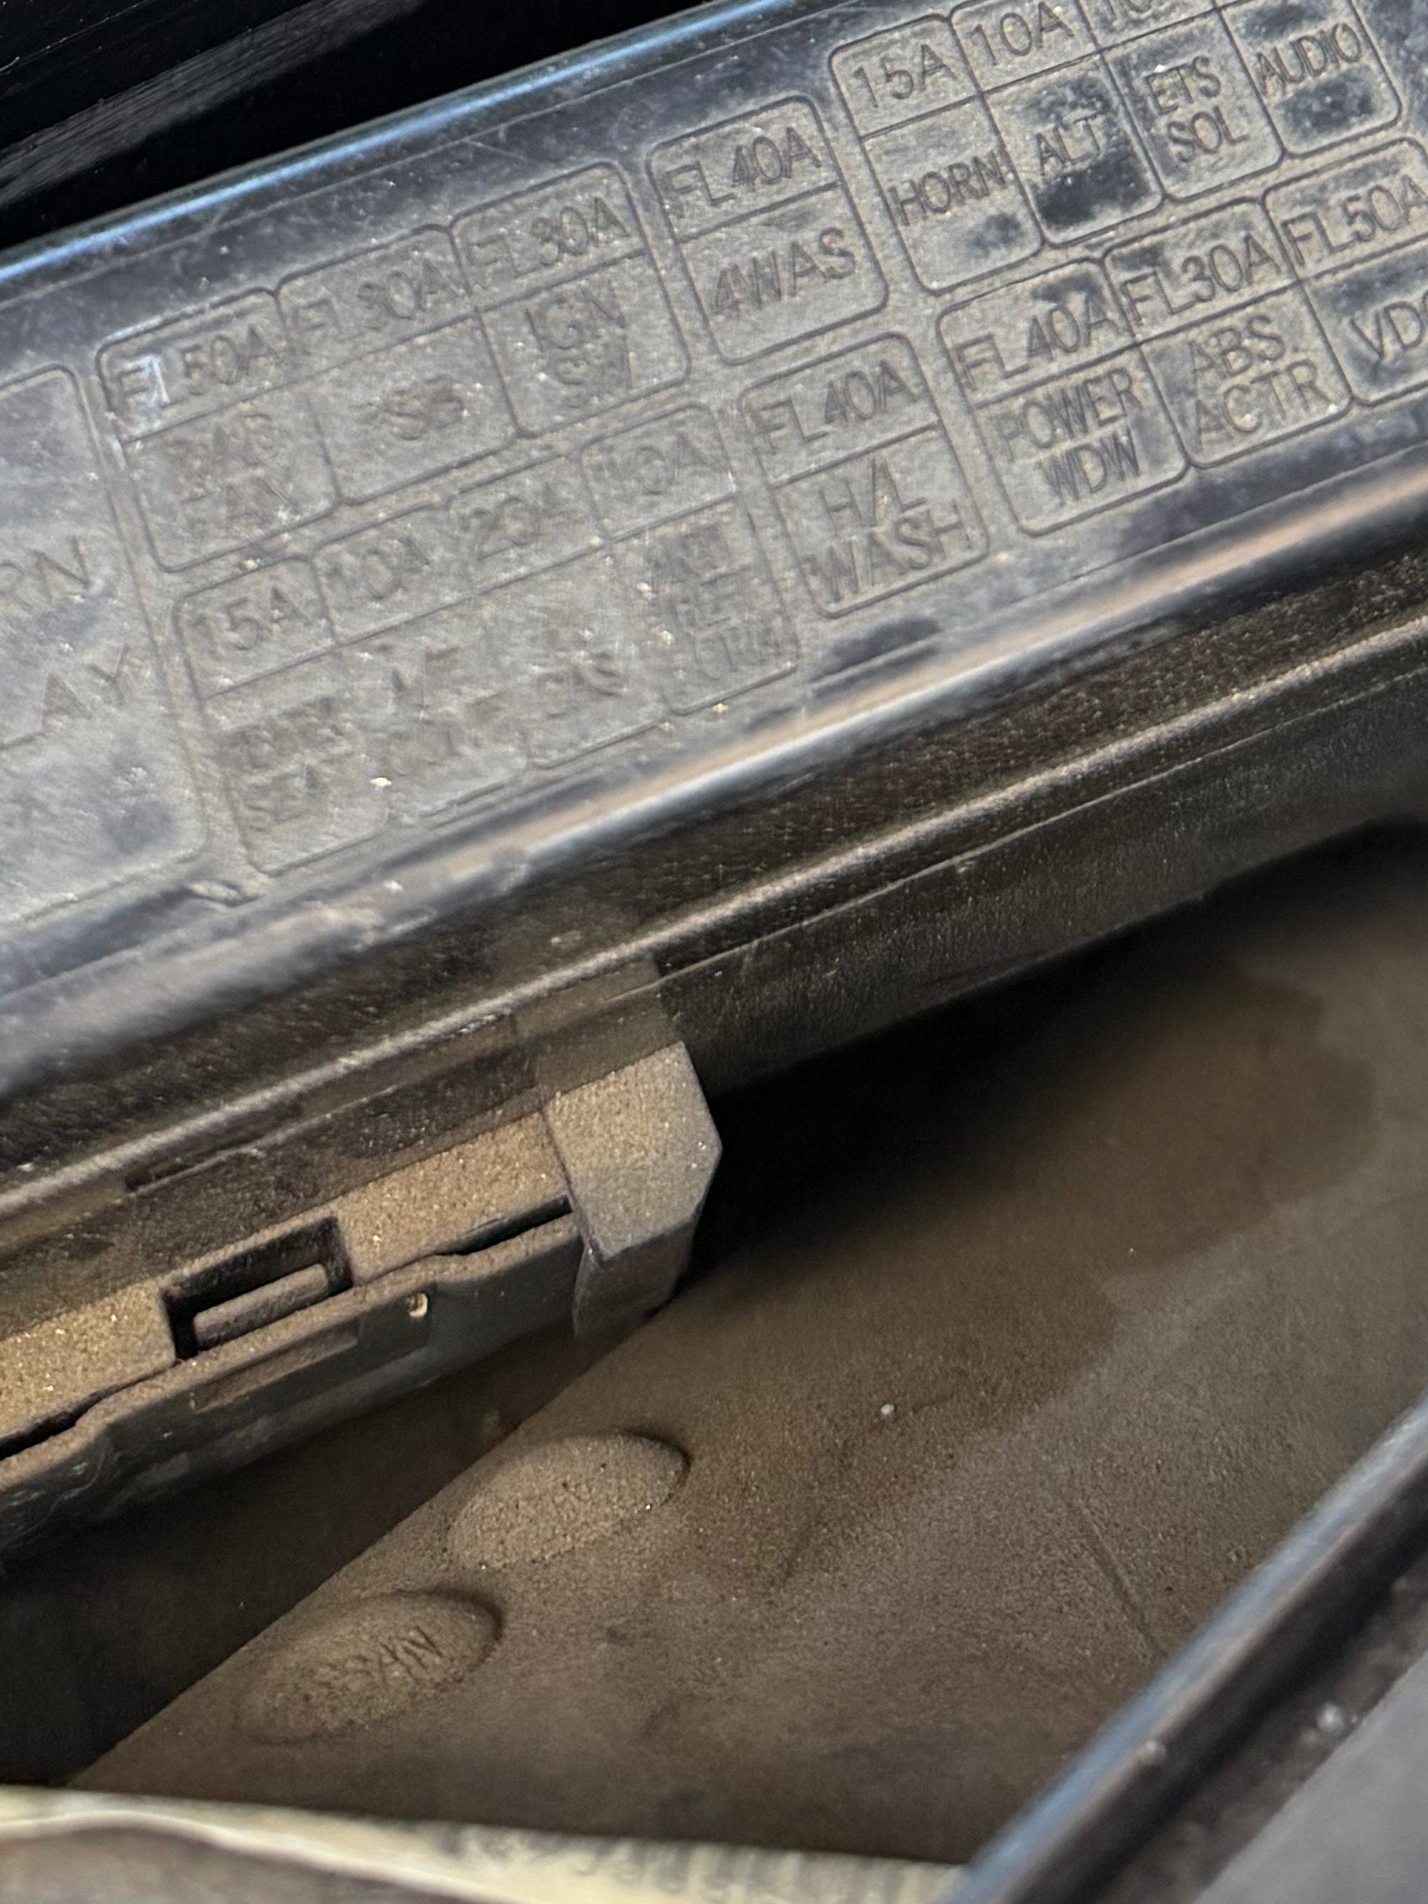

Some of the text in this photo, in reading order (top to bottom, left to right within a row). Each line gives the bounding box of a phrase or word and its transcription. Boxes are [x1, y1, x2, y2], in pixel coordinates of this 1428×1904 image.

[970, 0, 1072, 65] 10A
[1253, 23, 1365, 89] AUDIO
[853, 41, 953, 107] 15A
[1142, 56, 1224, 114] ETS
[662, 127, 817, 213] FL40A
[1027, 119, 1105, 172] ALT
[1164, 103, 1250, 162] SOL
[891, 155, 1004, 222] HORN
[704, 230, 855, 316] 4WAS
[1122, 235, 1276, 323] FL30A
[957, 295, 1115, 384] FL40A
[752, 359, 913, 453] FL40A
[998, 370, 1142, 455] POWER
[1188, 361, 1331, 447] ACTR
[815, 452, 925, 535] H/L
[1040, 431, 1146, 503] WDW
[809, 505, 971, 600] WASH
[194, 582, 307, 660] 15A
